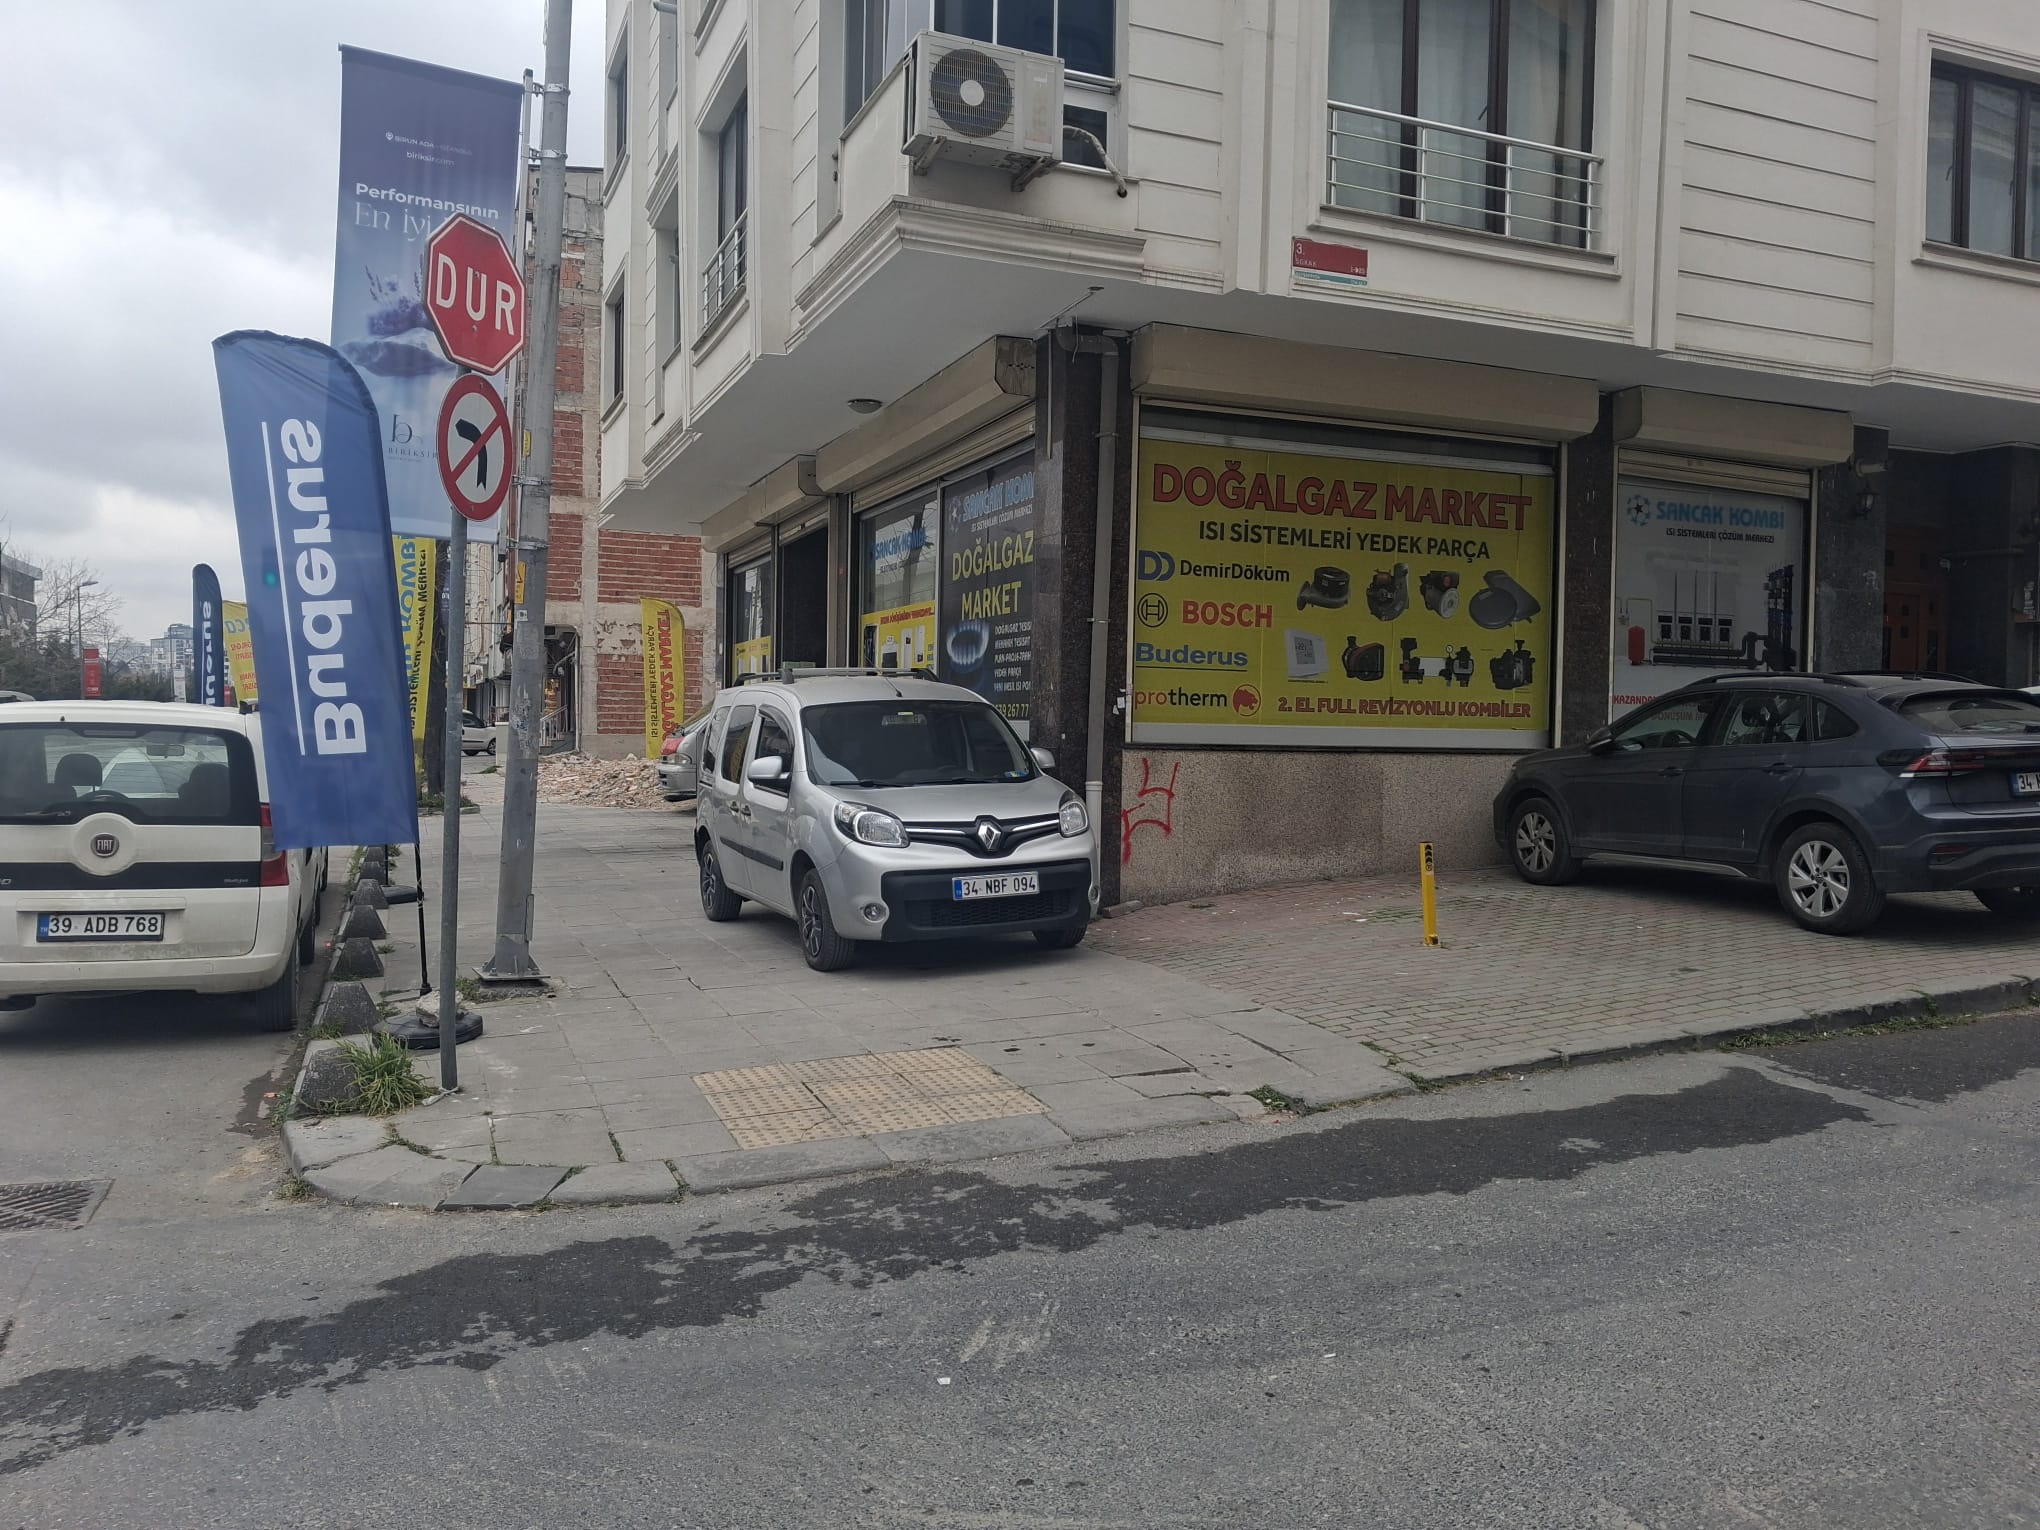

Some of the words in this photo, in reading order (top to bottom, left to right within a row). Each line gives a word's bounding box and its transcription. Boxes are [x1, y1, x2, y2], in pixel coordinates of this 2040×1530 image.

[356, 182, 499, 220] Performansının
[355, 201, 390, 230] En
[436, 252, 516, 336] DUR
[1153, 459, 1378, 521] DOĞALGAZ
[1384, 484, 1532, 531] MARKET
[1656, 500, 1723, 525] SANCAK
[1729, 506, 1785, 530] KOMBİ
[1200, 520, 1226, 542] ISI
[1230, 518, 1352, 551] SİSTEMLERİ
[1356, 531, 1422, 554] YEDEK
[1427, 536, 1490, 564] PARÇA
[952, 530, 1034, 581] DOĞALGAZ
[400, 532, 416, 632] KOMB
[1180, 559, 1290, 582] DemirDöküm
[961, 580, 1022, 621] MARKET
[1182, 600, 1273, 628] BOSCH
[1136, 642, 1249, 668] Buderus
[1007, 703, 1020, 718] 267
[1135, 687, 1228, 710] protherm
[1278, 696, 1293, 713] 2.
[1296, 697, 1316, 713] EL
[1318, 697, 1357, 714] FULL
[1359, 696, 1456, 717] REVİZYONLU
[1458, 699, 1532, 718] KOMBİLER
[2018, 774, 2033, 790] 34
[96, 839, 114, 851] FIAT
[963, 881, 979, 896] 34
[985, 878, 1008, 895] NBF
[1013, 876, 1036, 892] 094
[49, 917, 73, 934] 39
[83, 916, 119, 934] ADB
[123, 916, 159, 934] 768
